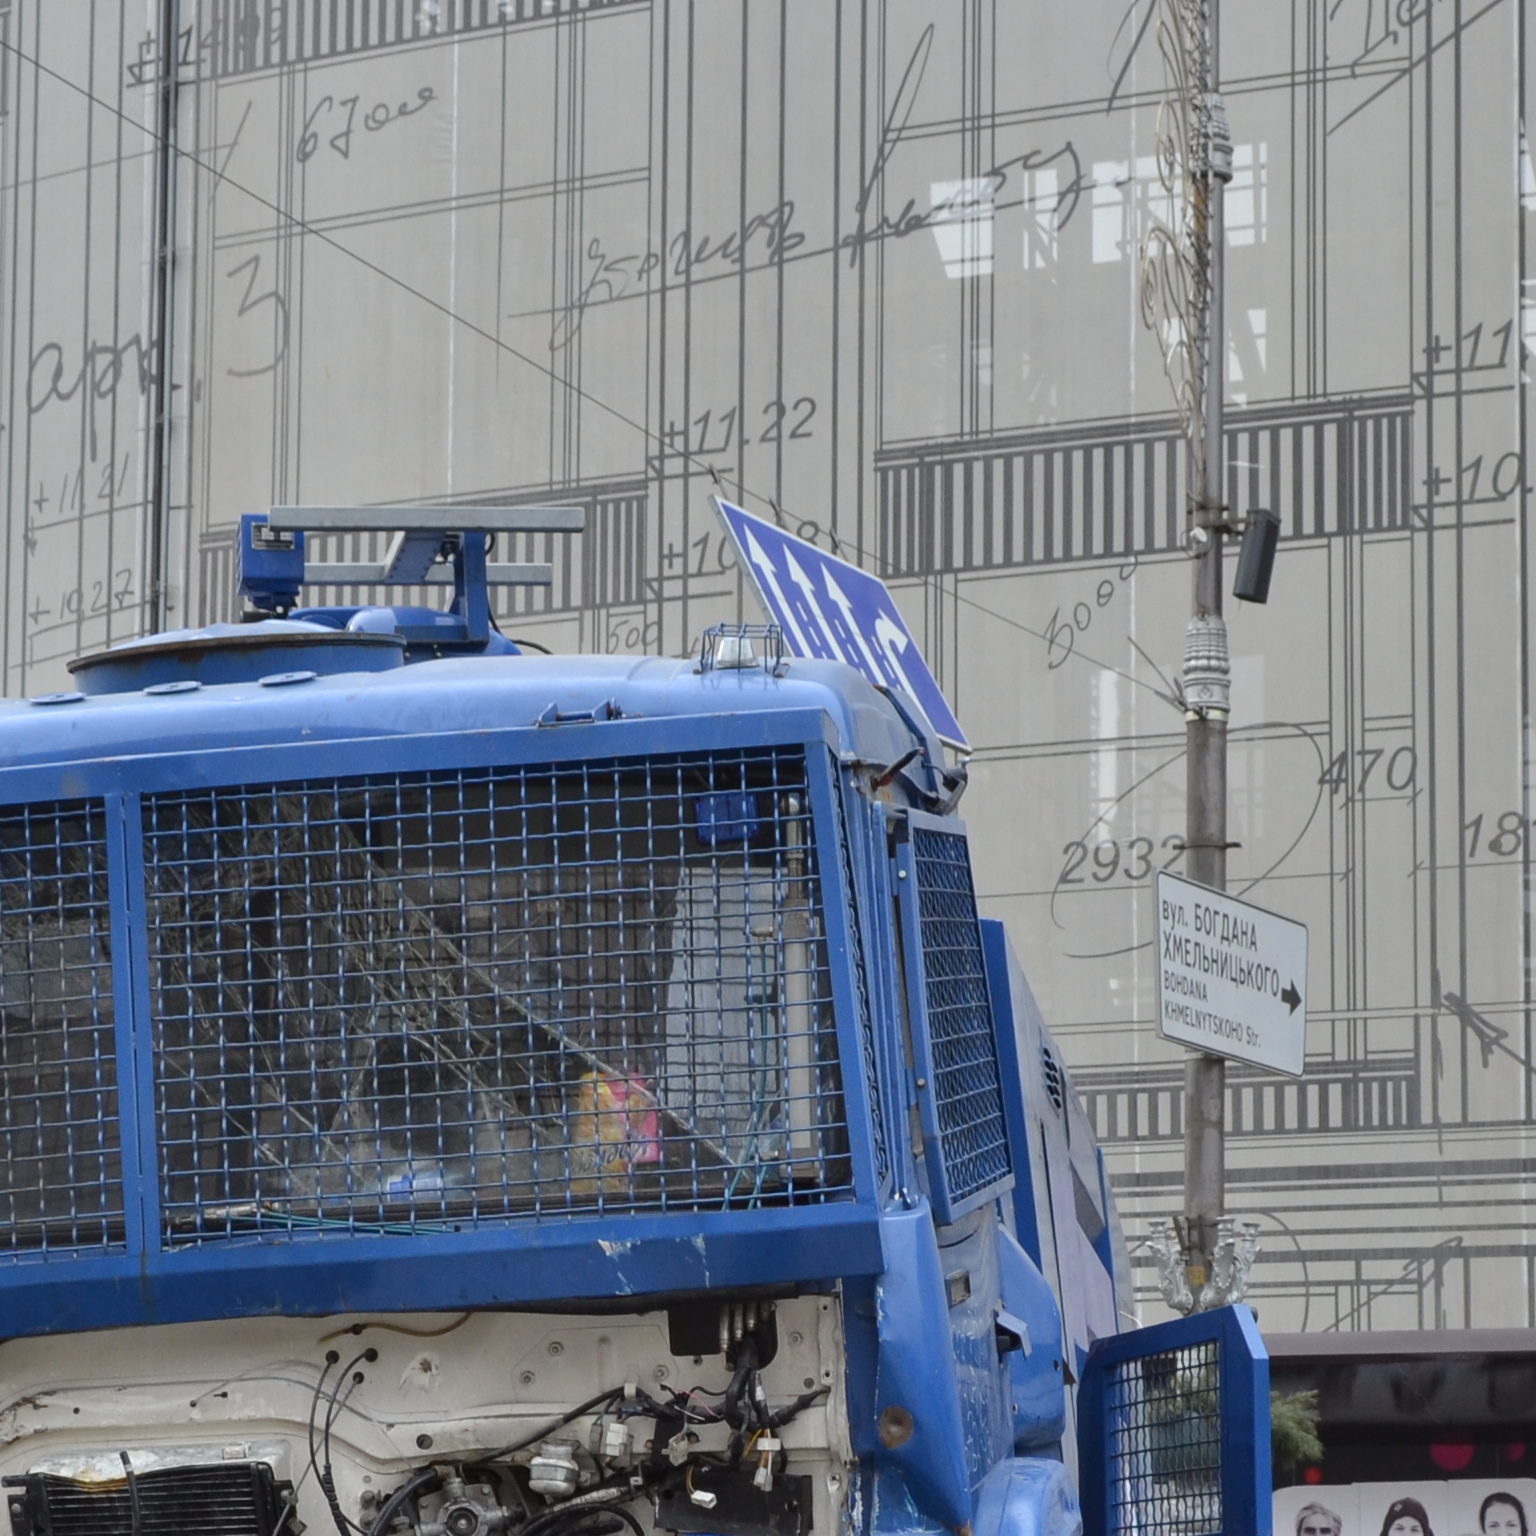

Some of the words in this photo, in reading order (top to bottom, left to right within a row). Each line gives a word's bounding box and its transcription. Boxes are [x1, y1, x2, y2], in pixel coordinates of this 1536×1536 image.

[662, 396, 818, 454] +11.22
[1317, 745, 1418, 796] 470
[1162, 899, 1189, 931] вул.
[1194, 903, 1258, 952] БОГДАНА
[1163, 930, 1280, 998] ХМЕЛЬНИЦЬКОГО
[1164, 969, 1208, 1002] BOHDANA
[1164, 999, 1244, 1043] KHMELNYTSKOHO
[1245, 1025, 1262, 1048] Str.
